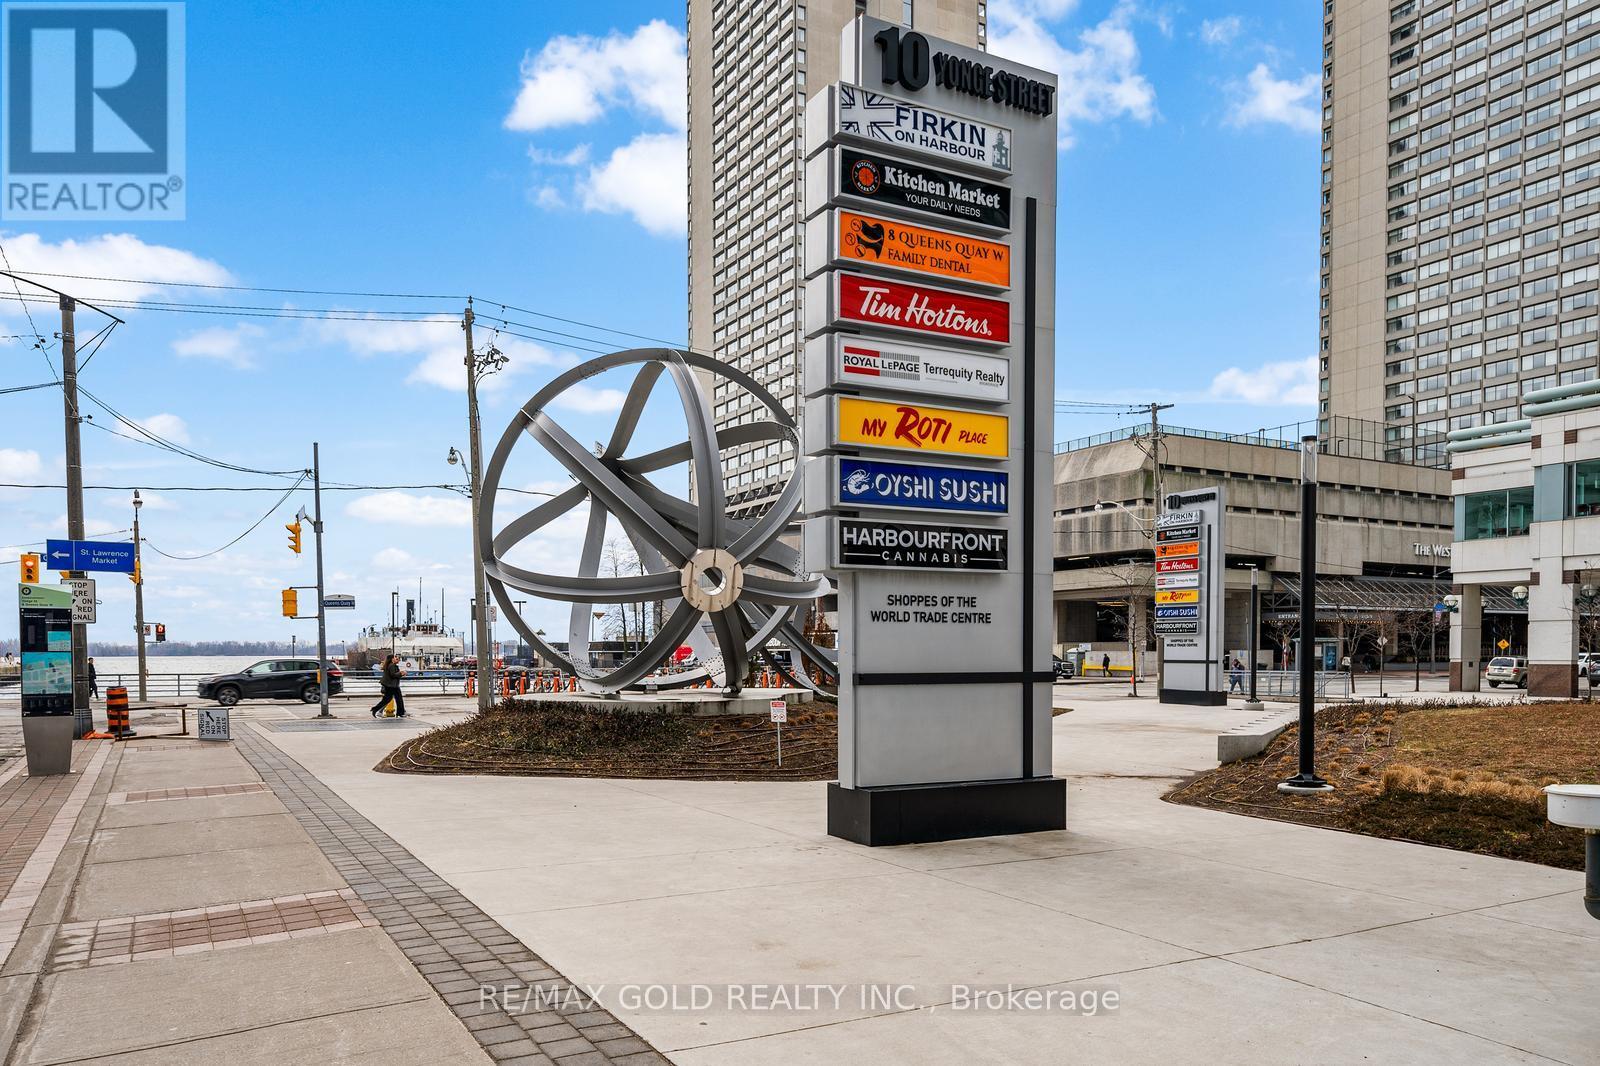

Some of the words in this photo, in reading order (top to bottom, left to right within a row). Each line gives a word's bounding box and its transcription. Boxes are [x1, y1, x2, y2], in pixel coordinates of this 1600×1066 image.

[874, 26, 930, 92] 10
[932, 51, 993, 100] YONGE
[991, 69, 1055, 117] STREET
[895, 105, 986, 148] FIRKIN
[895, 129, 915, 142] ON
[919, 134, 986, 161] HARBOUR
[884, 166, 945, 198] Kitchen
[948, 180, 1000, 209] Market
[905, 193, 929, 206] YOUR
[930, 197, 953, 211] DAILY
[954, 202, 981, 218] NEEDS
[888, 229, 895, 241] 8
[899, 230, 952, 252] QUEENS
[955, 240, 990, 260] QUAY
[992, 248, 1004, 261] W
[888, 248, 927, 269] FAMILY
[930, 255, 972, 274] DENTAL
[858, 285, 901, 320] Tim
[843, 355, 879, 369] ROYAL
[923, 362, 973, 382] Terrequity
[976, 369, 1005, 386] Realty
[861, 417, 887, 438] MY
[894, 406, 952, 447] ROTI
[958, 429, 988, 444] PLACE
[875, 472, 934, 500] OYSHI
[939, 477, 1005, 505] SUSHI
[1167, 494, 1180, 509] 10
[1170, 512, 1193, 520] FIRKIN
[843, 526, 1003, 552] HARBOURFRONT
[1413, 543, 1431, 556] THE
[1432, 544, 1451, 557] WES
[80, 548, 90, 556] St.
[92, 549, 129, 557] Lawrence
[882, 550, 968, 564] CANNABIS
[1160, 562, 1171, 571] Tim
[887, 594, 937, 607] SHOPPES
[941, 595, 954, 607] OF
[956, 596, 977, 608] THE
[870, 610, 911, 623] WORLD
[913, 611, 948, 623] TRADE
[951, 612, 992, 624] CENTRE
[211, 725, 216, 735] ON
